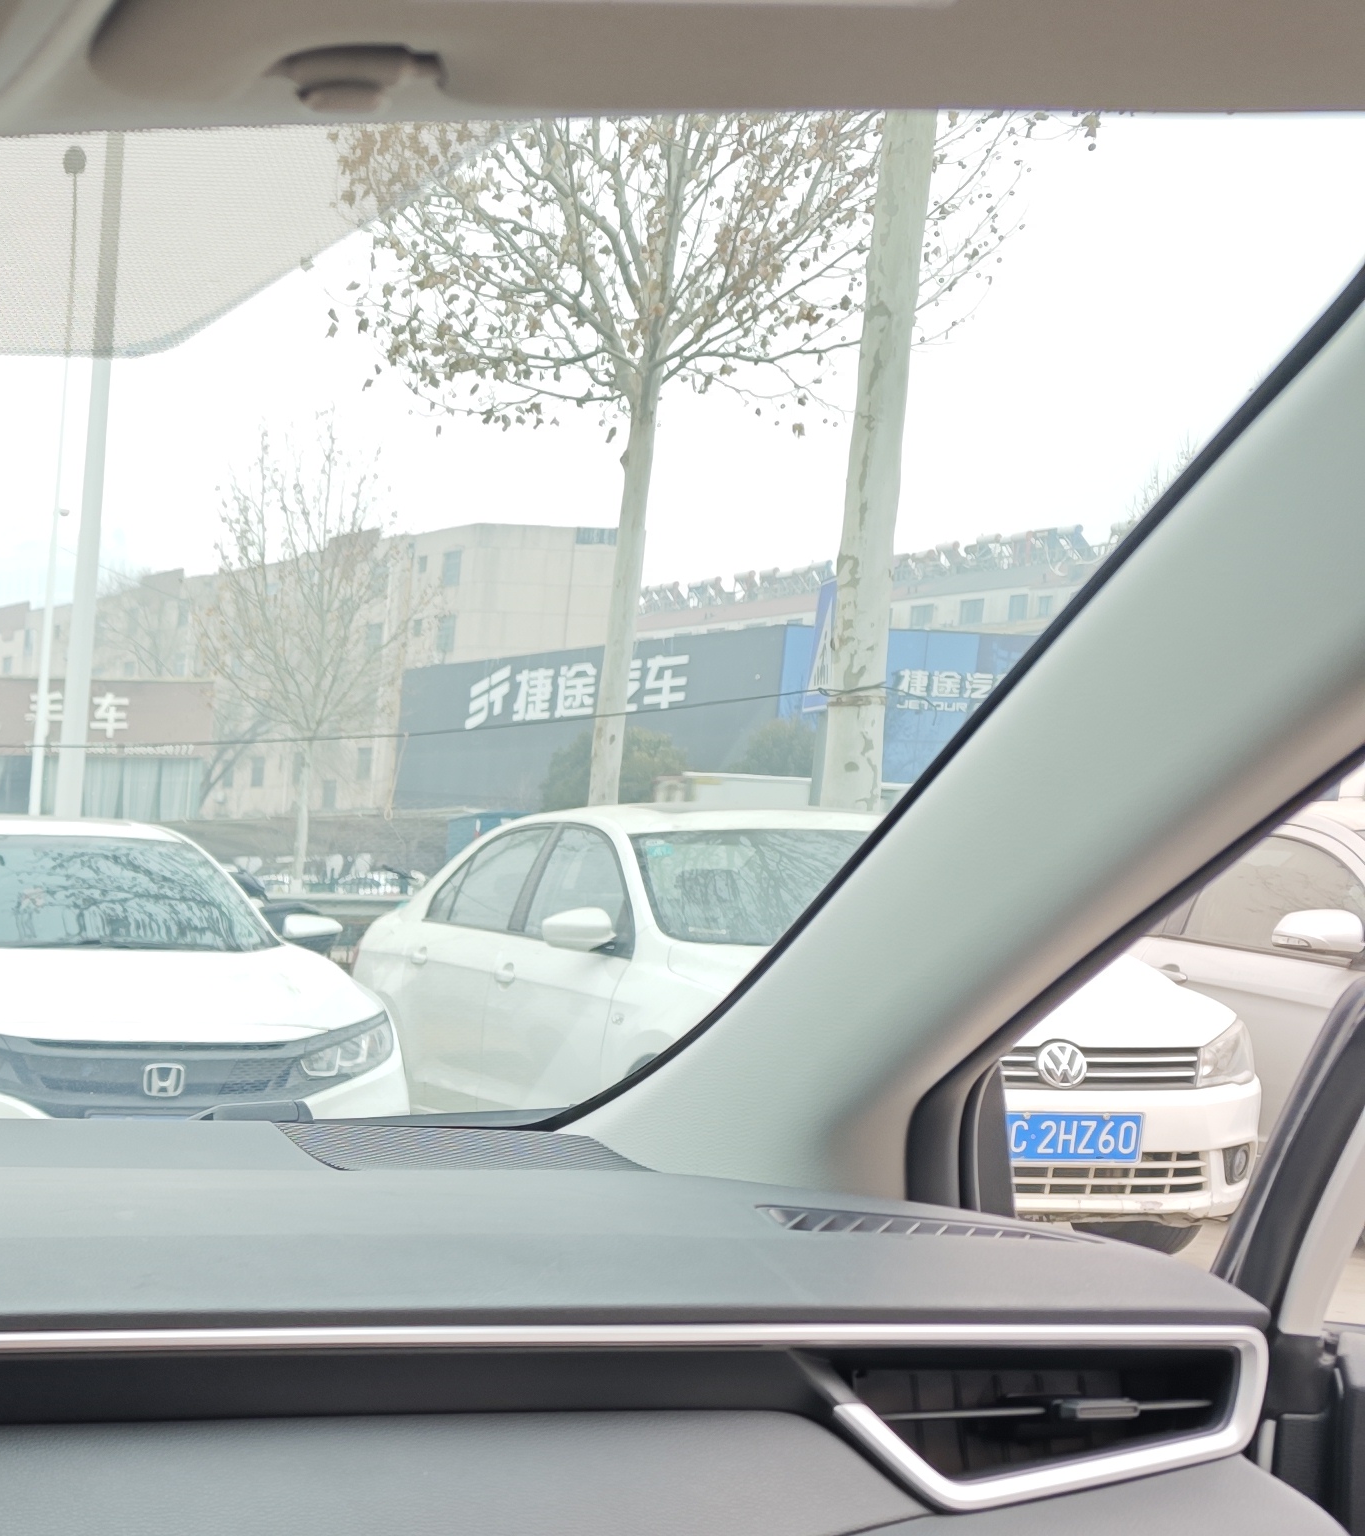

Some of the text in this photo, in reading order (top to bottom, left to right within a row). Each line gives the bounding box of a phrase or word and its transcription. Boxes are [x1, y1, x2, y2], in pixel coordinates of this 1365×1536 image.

[898, 668, 1006, 699] 捷途汽
[1011, 1120, 1137, 1155] C·2HZ60
